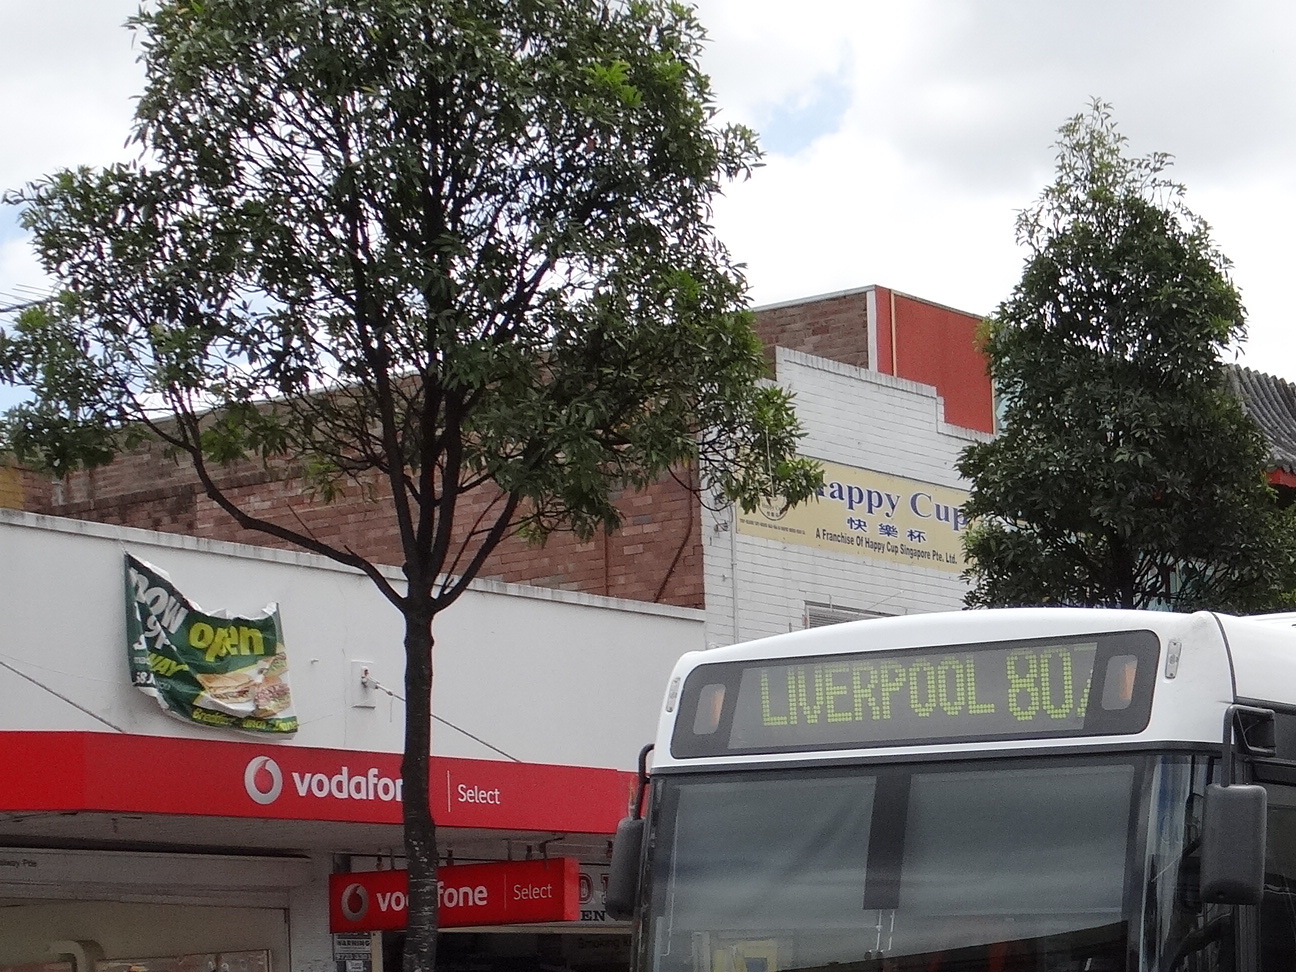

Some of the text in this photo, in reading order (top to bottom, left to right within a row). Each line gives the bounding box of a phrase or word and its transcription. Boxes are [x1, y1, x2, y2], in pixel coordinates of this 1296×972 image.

[846, 516, 926, 543] 快樂杯
[910, 492, 968, 531] Cup
[815, 527, 821, 539] A
[822, 529, 854, 546] Franchise
[855, 535, 864, 547] Of
[865, 538, 885, 554] Happy
[886, 541, 899, 555] Cup
[899, 543, 931, 560] Singapore
[945, 552, 957, 564] Ltd.
[760, 653, 995, 727] LIVERPOOL
[291, 766, 501, 805] vodafo Select
[376, 881, 553, 912] vofone Select
